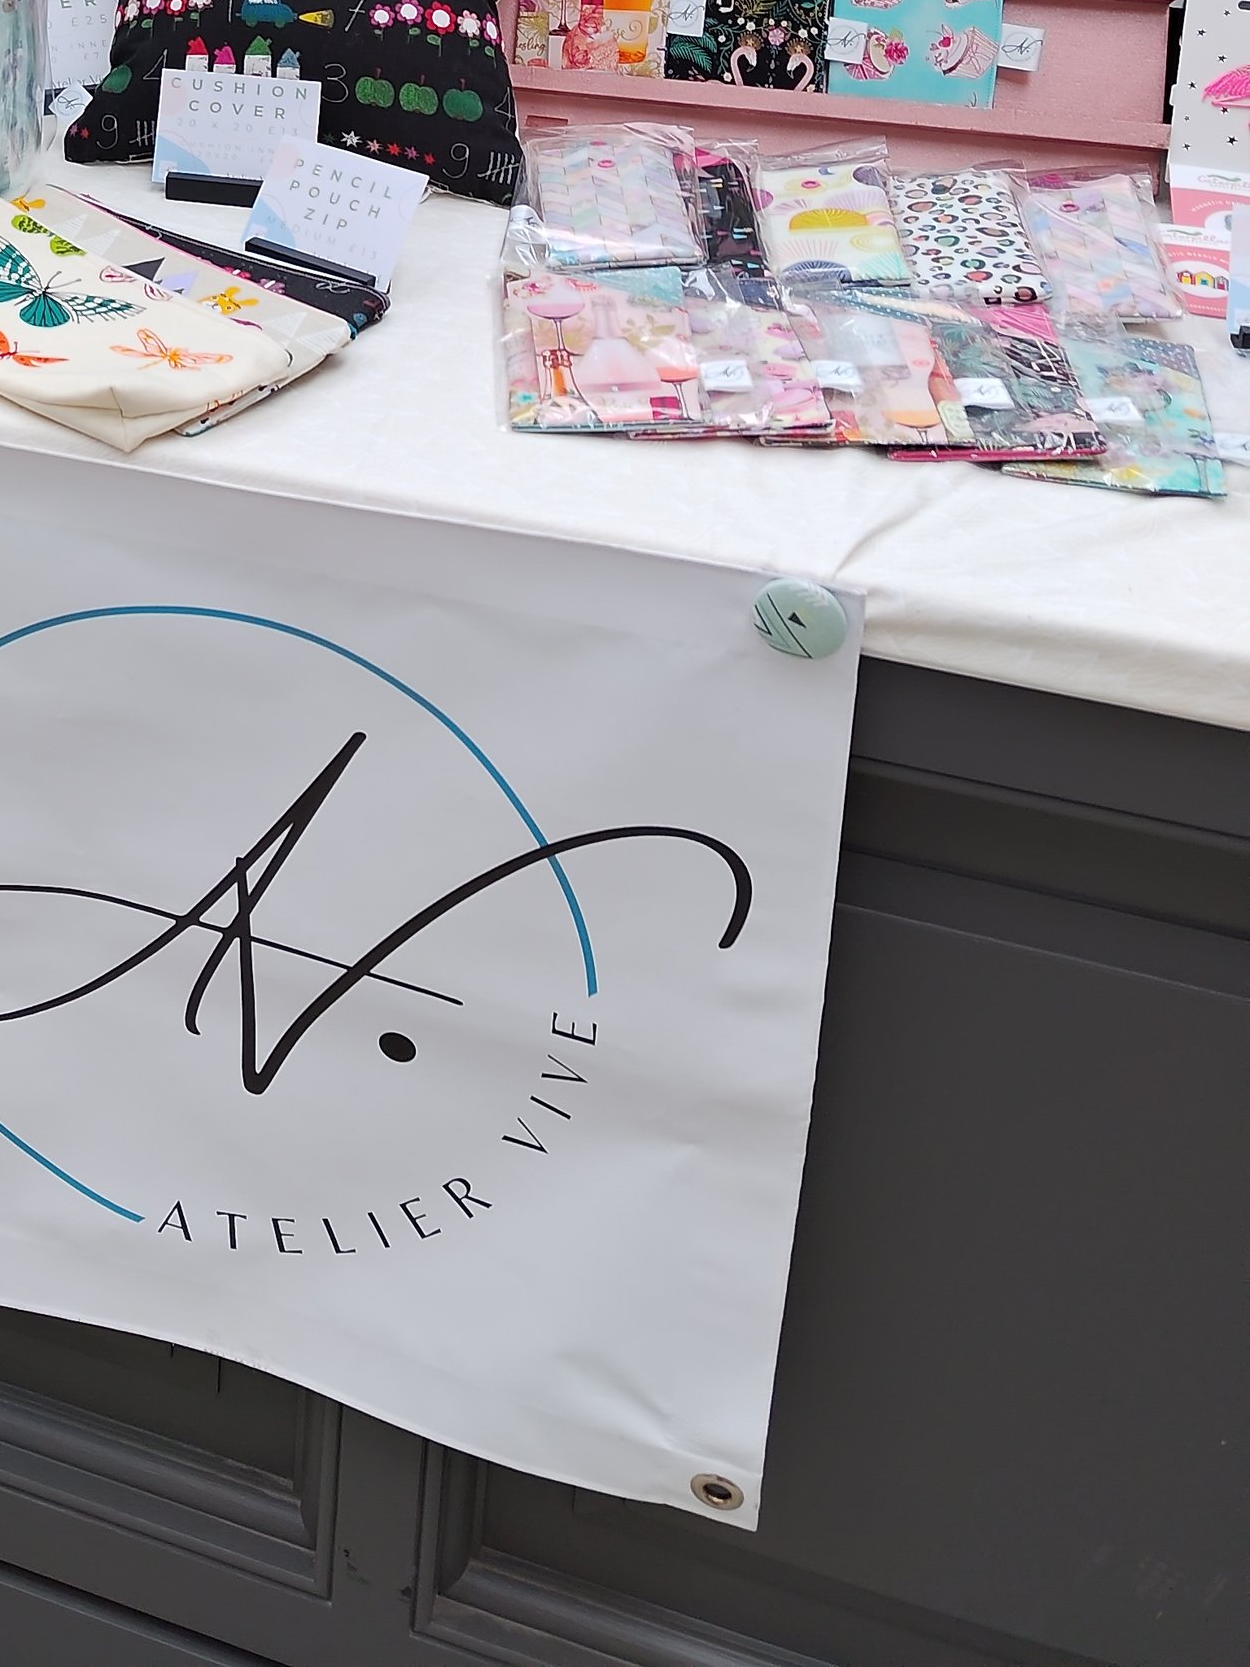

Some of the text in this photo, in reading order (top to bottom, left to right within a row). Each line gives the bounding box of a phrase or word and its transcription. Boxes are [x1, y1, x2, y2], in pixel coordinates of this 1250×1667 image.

[71, 15, 108, 27] £25
[171, 77, 307, 101] CUSHION
[322, 62, 350, 105] 3
[188, 100, 286, 120] COVER
[95, 115, 119, 150] 9
[294, 158, 393, 199] PENCIL
[441, 144, 469, 179] 9
[289, 179, 381, 219] POUCH
[304, 207, 348, 230] ZIP
[157, 1014, 598, 1255] ATELIER VIVE
